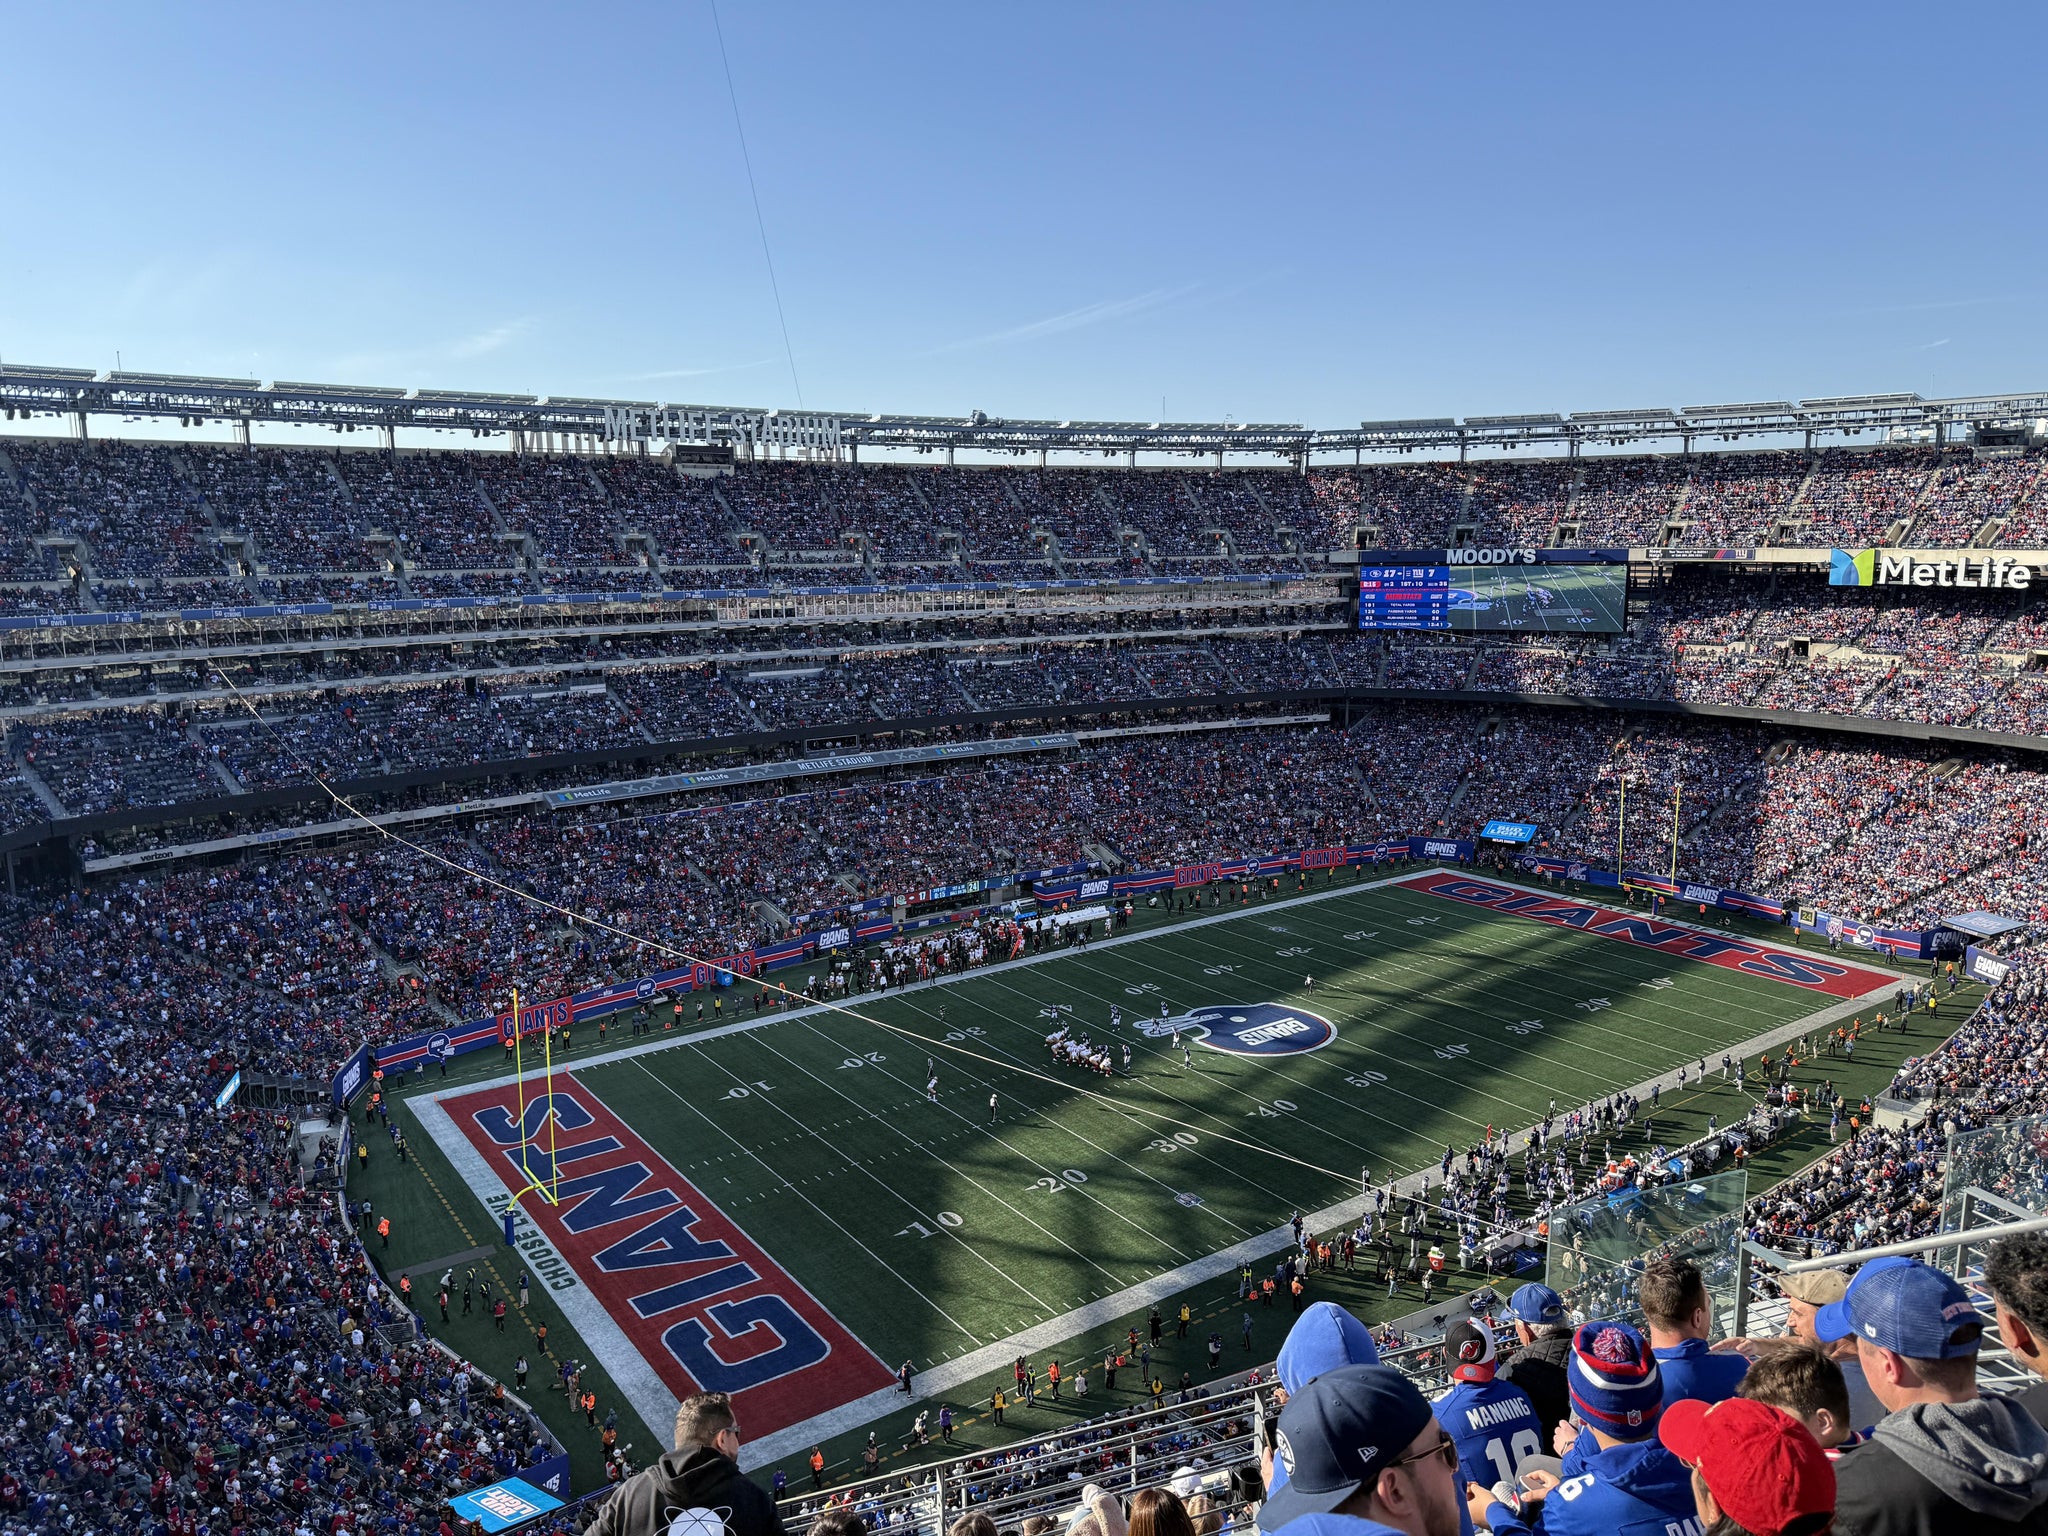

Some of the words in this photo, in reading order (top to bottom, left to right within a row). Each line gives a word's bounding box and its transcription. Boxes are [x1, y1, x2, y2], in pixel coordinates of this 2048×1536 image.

[603, 407, 720, 445] METLIFE
[730, 414, 841, 449] STADIUM
[1446, 549, 1536, 564] MOODY'S
[1429, 569, 1435, 577] 7
[1879, 556, 2032, 589] MetLife
[1040, 737, 1068, 745] MetLife
[946, 746, 974, 754] MetLife
[798, 760, 836, 771] METLIFE
[837, 755, 874, 767] STADIUM
[696, 773, 730, 784] MetLife
[574, 788, 612, 799] MetLife
[464, 803, 486, 811] MetLife
[257, 830, 295, 843] HCLTech
[1490, 829, 1525, 837] LIGHT
[139, 850, 173, 862] verizon
[1425, 841, 1457, 855] GIANTS
[1304, 849, 1344, 867] GIANTS
[1178, 864, 1219, 886] GIANTS
[968, 882, 977, 891] 24
[984, 880, 988, 888] 7
[1081, 880, 1109, 894] GIANTS
[1685, 884, 1719, 901] GIANTS
[919, 891, 926, 900] 17
[1407, 916, 1438, 926] 10
[1802, 912, 1812, 920] 24
[820, 928, 849, 946] GIANTS
[1343, 930, 1376, 941] 20
[1429, 879, 1849, 985] GIANTS
[1718, 931, 1747, 940] US
[1275, 947, 1309, 958] 30
[1203, 964, 1238, 977] 40
[1126, 982, 1162, 995] 50
[1639, 976, 1675, 991] 10
[1575, 998, 1613, 1012] 20
[503, 1002, 568, 1038] GIANTS
[1505, 1019, 1545, 1036] 30
[945, 1026, 988, 1042] 30
[1239, 1019, 1311, 1046] GIANTS
[842, 1050, 888, 1069] 20
[1433, 1045, 1471, 1062] 40
[342, 1060, 361, 1094] GIANTS
[1345, 1070, 1389, 1088] 50
[728, 1079, 777, 1100] 10
[1256, 1099, 1299, 1119] 40
[1149, 1131, 1200, 1154] 30
[1036, 1168, 1089, 1195] 20
[912, 1210, 965, 1240] 10
[471, 1091, 832, 1396] GIANTS
[515, 1229, 577, 1291] CHOOSE
[1465, 1397, 1531, 1431] MANNING
[480, 1496, 518, 1517] BUD
[486, 1488, 535, 1515] LIGHT
